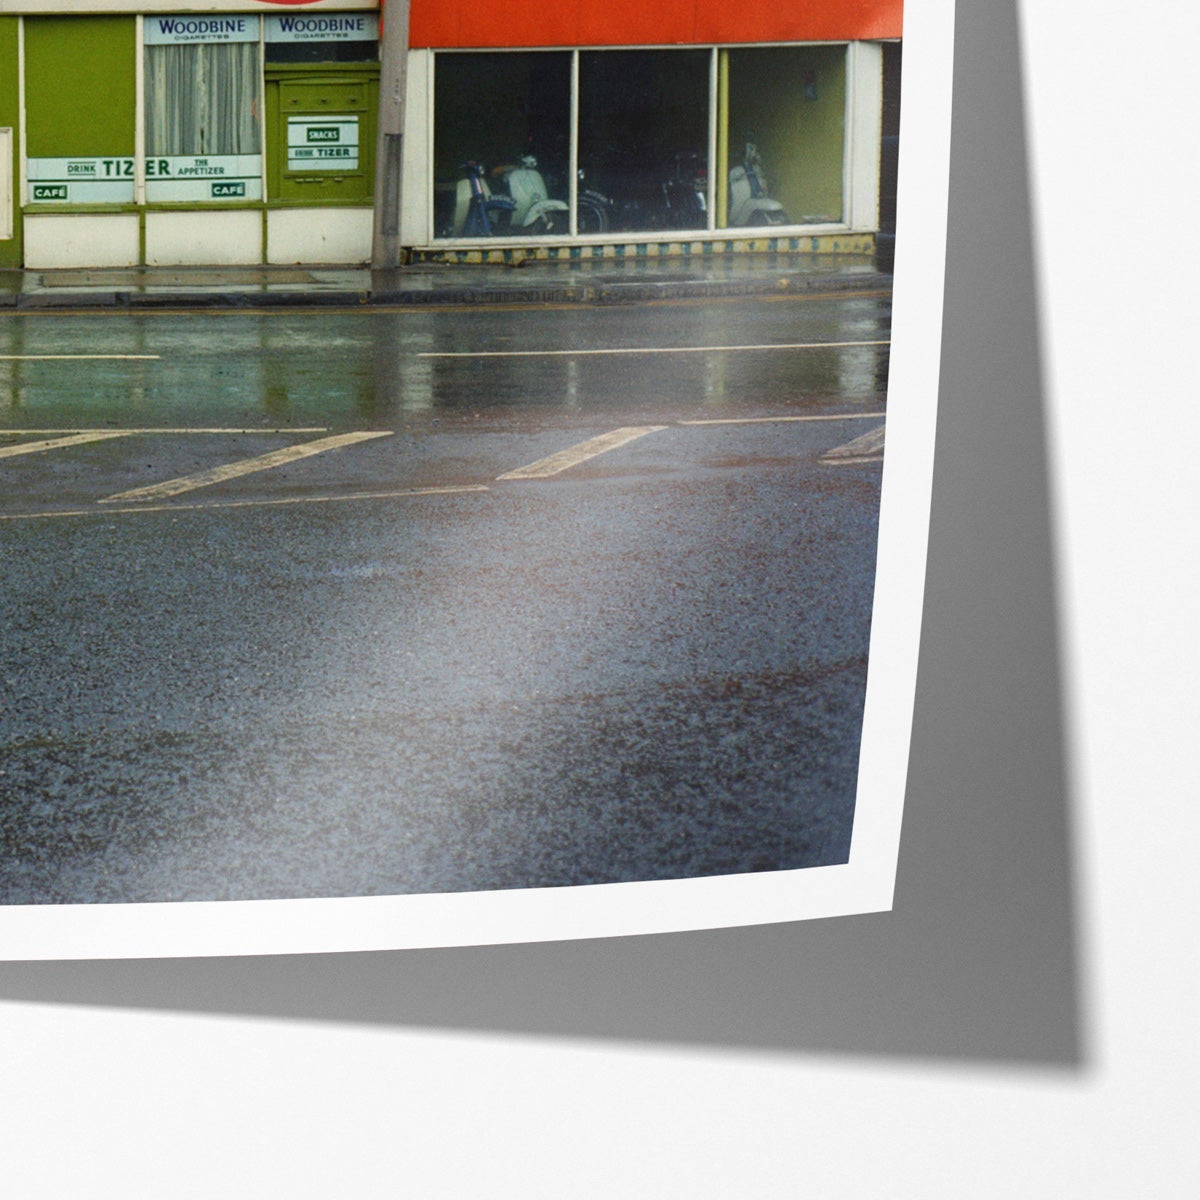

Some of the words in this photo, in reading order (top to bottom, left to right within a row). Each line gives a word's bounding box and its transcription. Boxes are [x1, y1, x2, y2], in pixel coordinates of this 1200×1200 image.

[159, 19, 246, 34] WOODBINE
[279, 17, 365, 32] WOODBINE
[309, 130, 338, 140] SNACKS
[317, 148, 350, 157] TIZER
[67, 164, 96, 173] DRINK
[178, 166, 224, 176] APPETIZER
[34, 186, 66, 198] CAFÉ
[212, 183, 244, 195] CAFÉ
